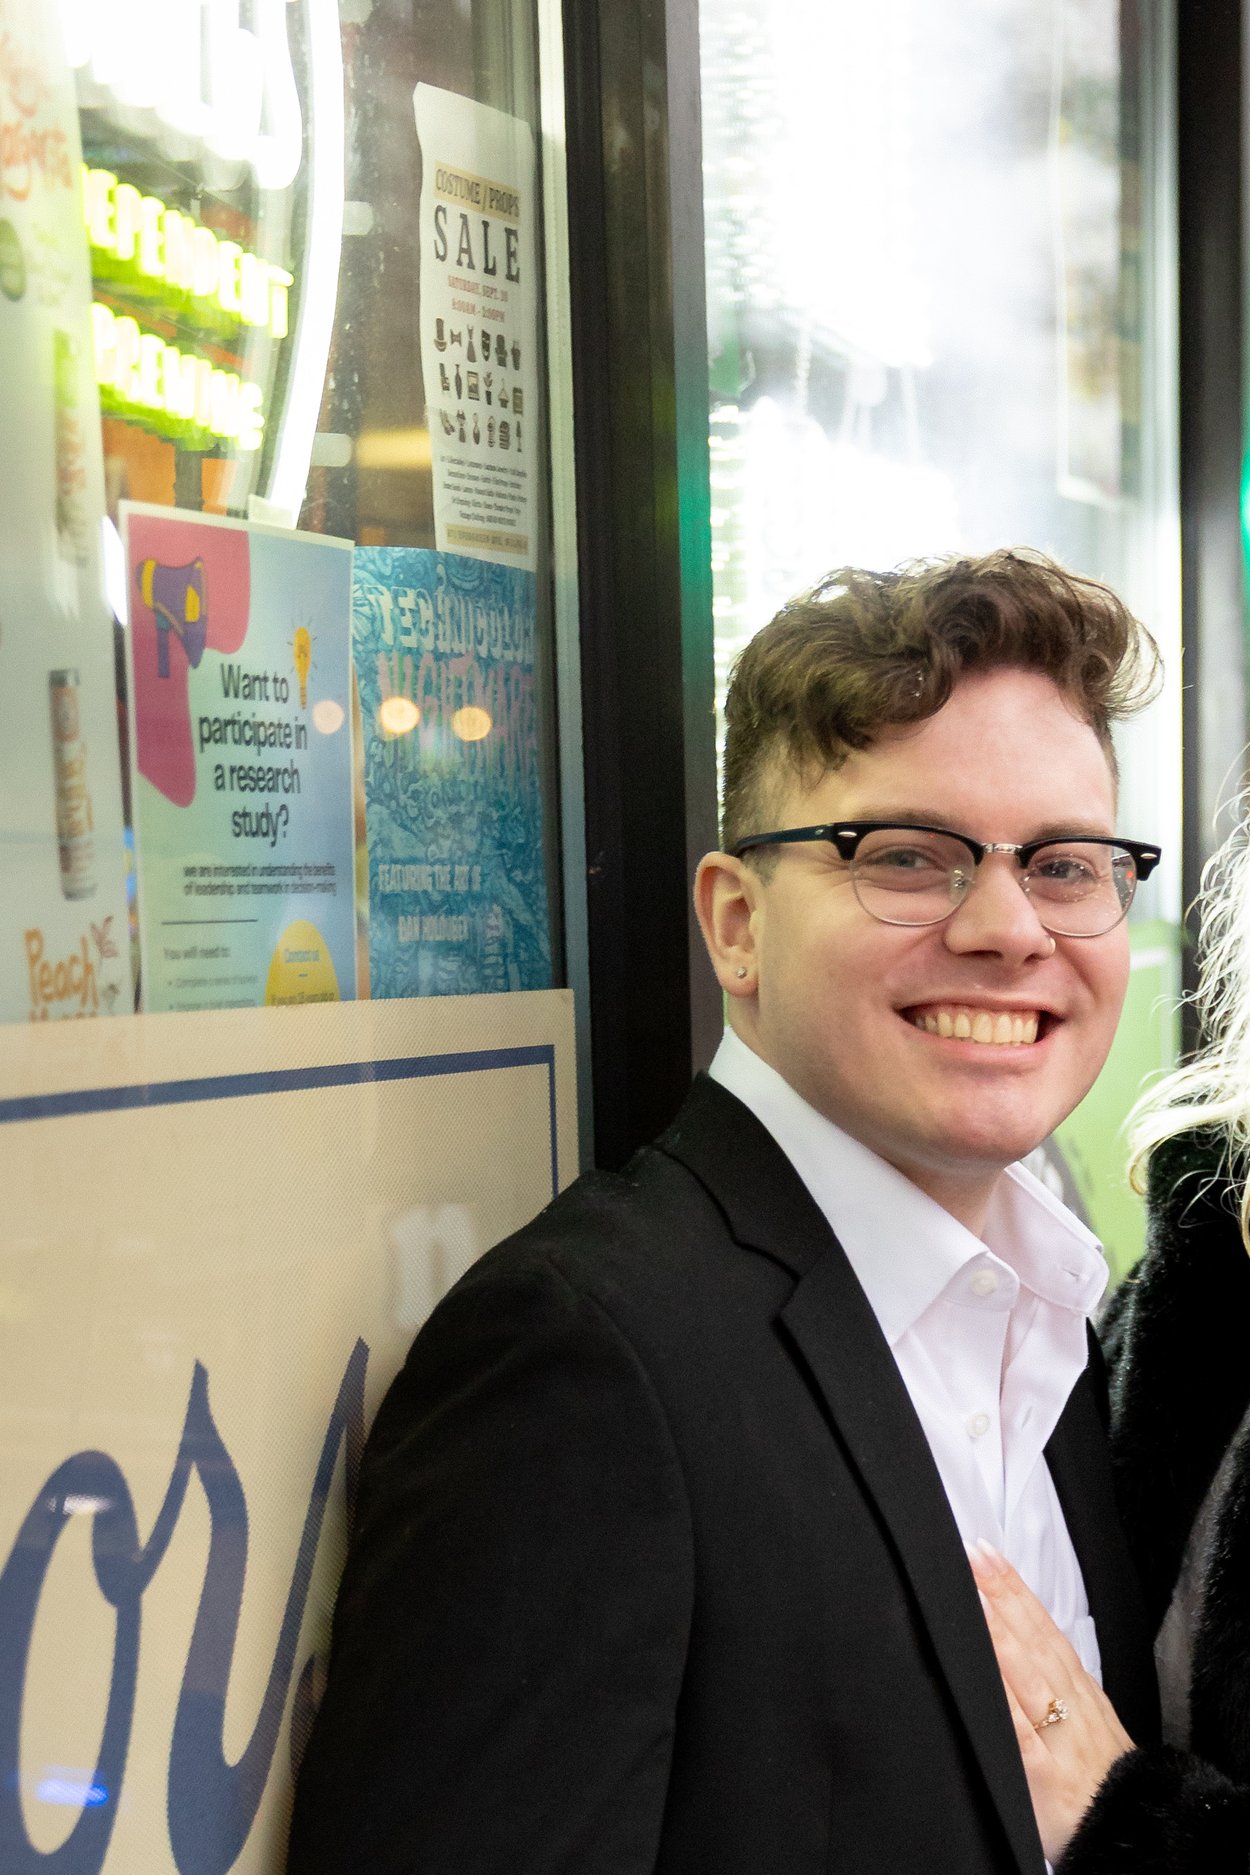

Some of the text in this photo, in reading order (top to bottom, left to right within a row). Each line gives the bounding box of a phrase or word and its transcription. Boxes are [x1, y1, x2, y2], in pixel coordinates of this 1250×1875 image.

[433, 204, 521, 283] SALE
[220, 662, 289, 704] Want to
[199, 711, 308, 757] participate in
[214, 759, 301, 794] a research
[232, 802, 289, 848] study?
